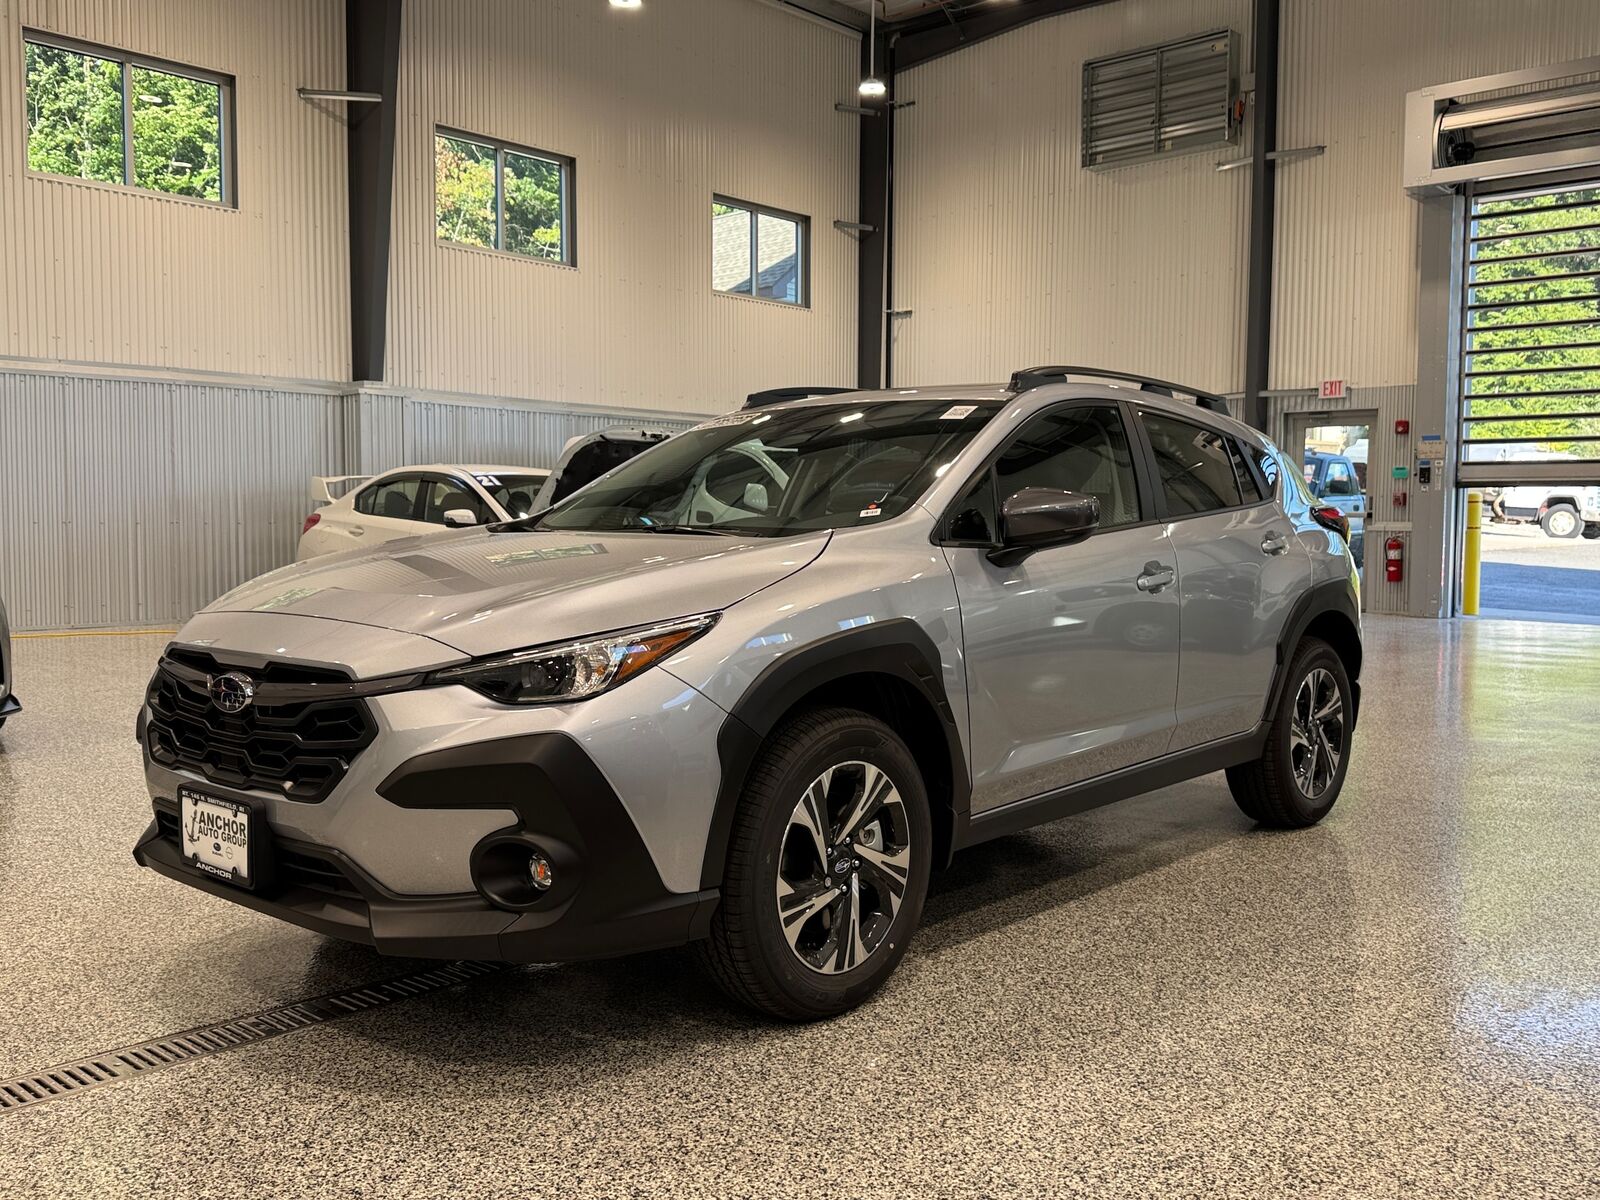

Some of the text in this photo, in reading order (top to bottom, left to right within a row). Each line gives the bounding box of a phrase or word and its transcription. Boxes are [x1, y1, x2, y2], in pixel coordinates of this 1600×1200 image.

[1323, 380, 1343, 396] EXIT
[476, 475, 503, 487] 21
[199, 810, 246, 838] ANCHOR
[198, 825, 246, 848] AUTO GROUP
[195, 862, 232, 880] ANCHOR
